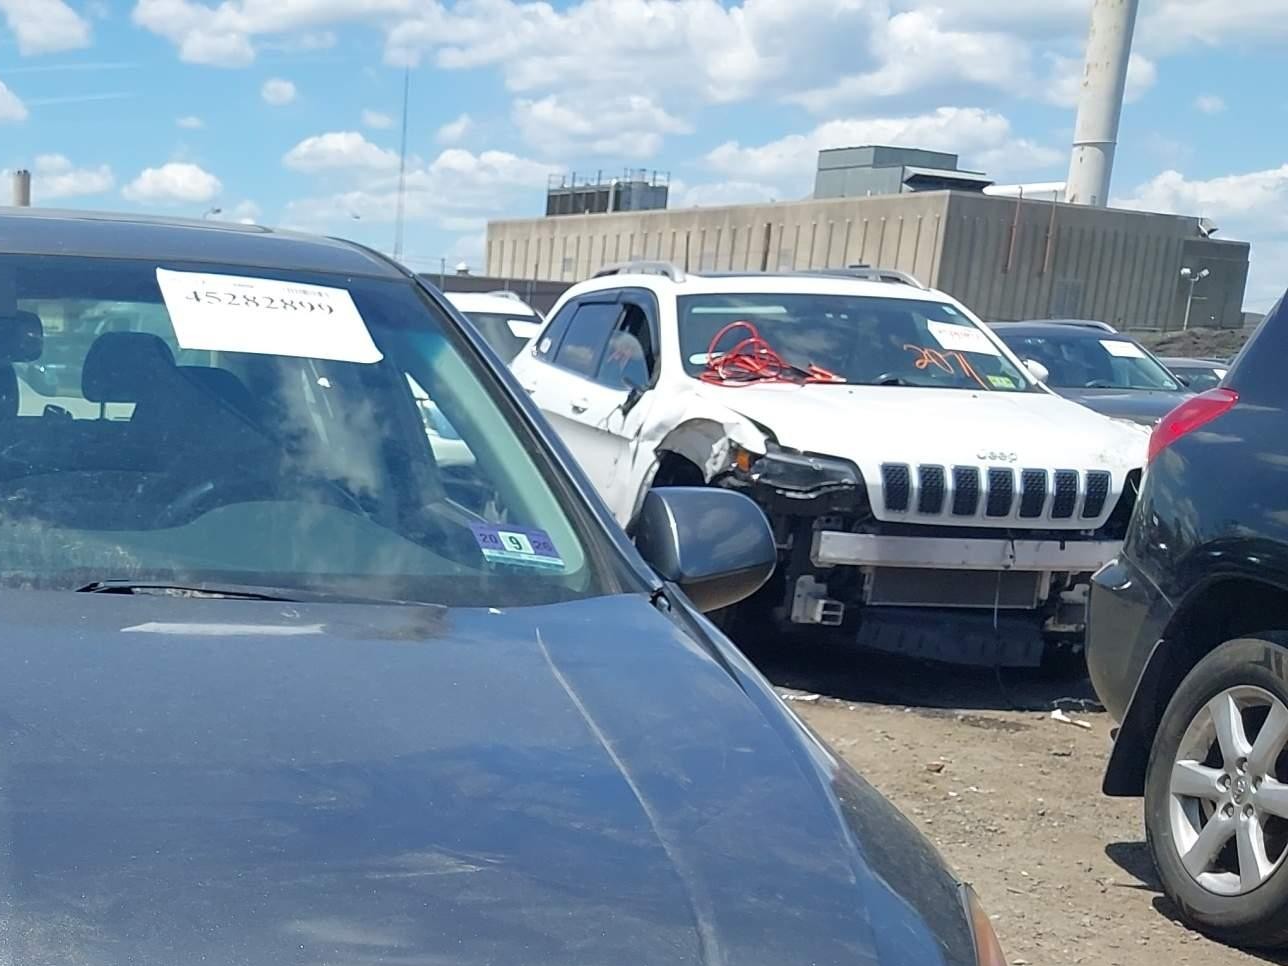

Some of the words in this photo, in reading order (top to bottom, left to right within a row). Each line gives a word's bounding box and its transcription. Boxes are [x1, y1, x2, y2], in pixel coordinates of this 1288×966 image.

[976, 449, 1018, 463] Jeep
[479, 533, 498, 544] 20
[508, 535, 523, 550] 9
